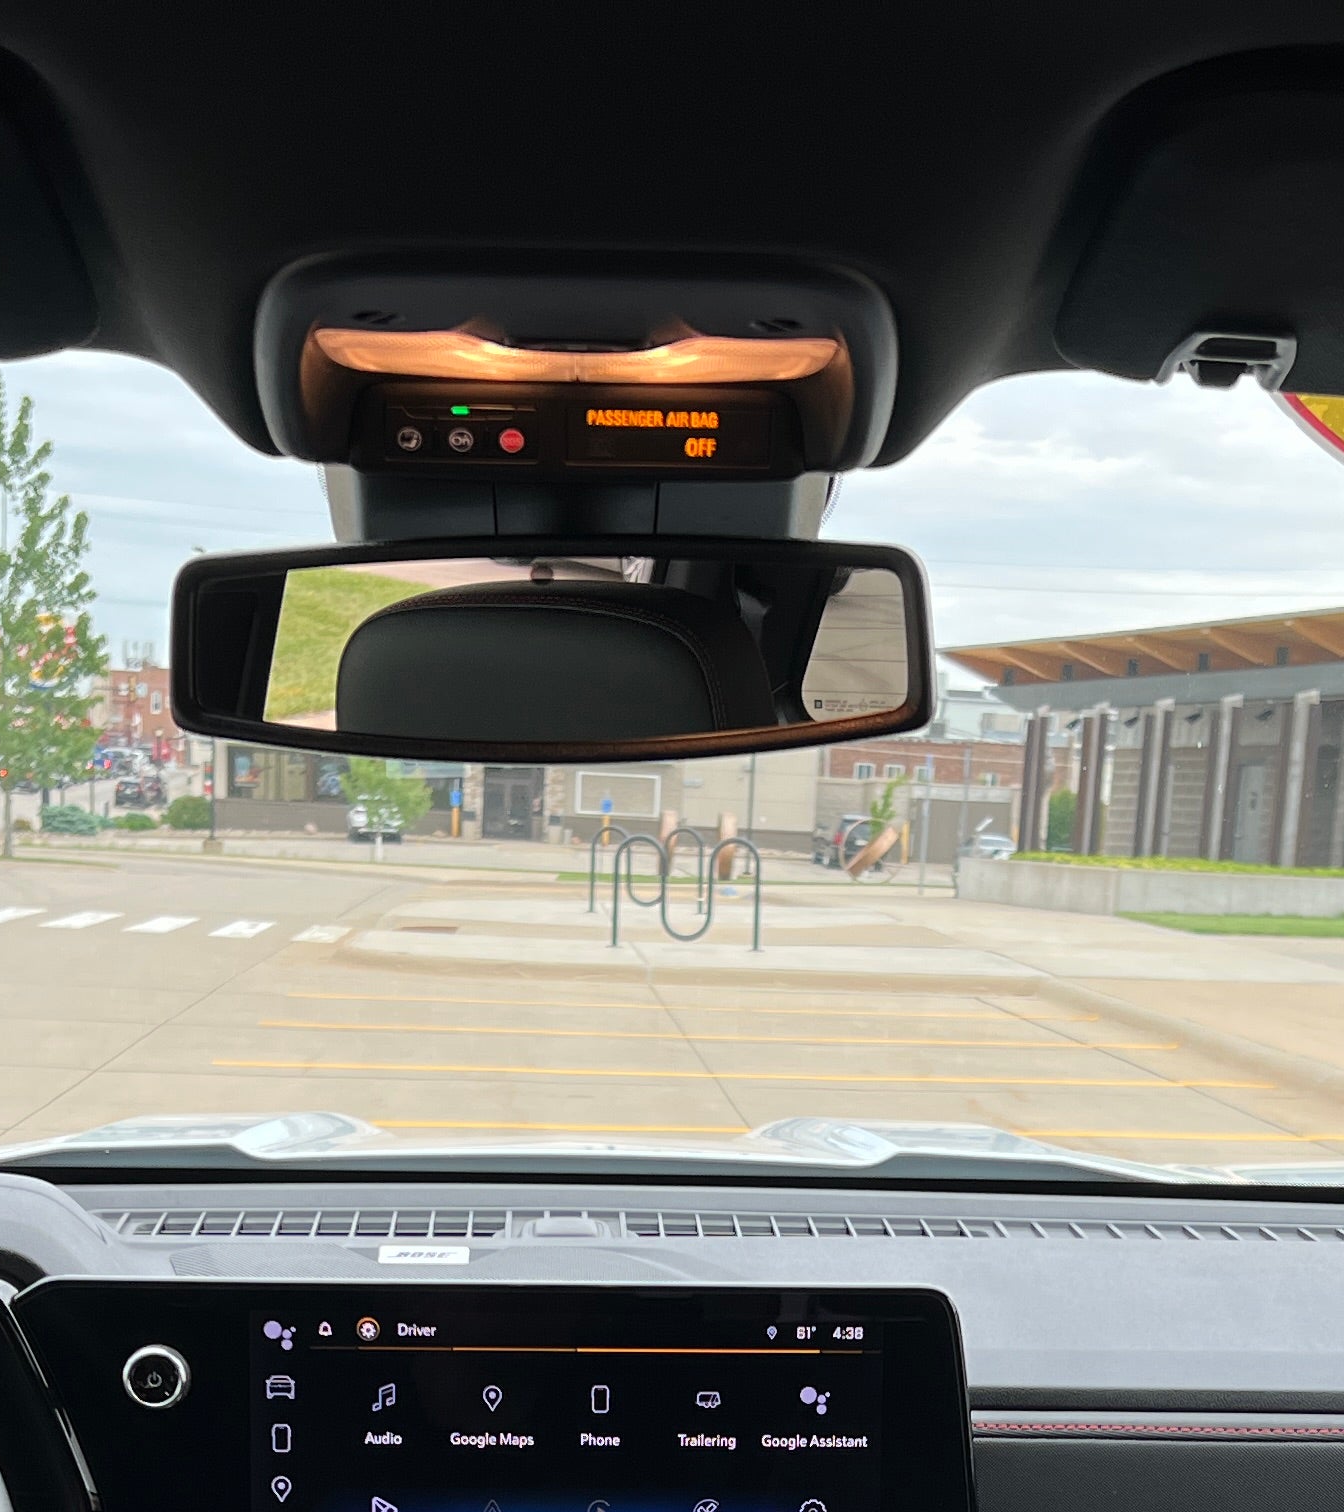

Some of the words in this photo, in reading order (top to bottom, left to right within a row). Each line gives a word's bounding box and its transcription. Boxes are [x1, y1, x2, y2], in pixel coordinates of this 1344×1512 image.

[586, 409, 663, 427] PASSENGER
[666, 411, 689, 427] AIR
[690, 411, 720, 429] BAG
[684, 437, 718, 458] OFF
[397, 1323, 437, 1338] Driver
[833, 1326, 864, 1340] 4:38
[365, 1431, 402, 1447] Audio
[450, 1432, 498, 1450] Google
[500, 1432, 535, 1450] Maps
[580, 1432, 621, 1447] Phone
[678, 1433, 737, 1451] Trailering
[761, 1434, 808, 1452] Google
[810, 1434, 868, 1449] Assistant
